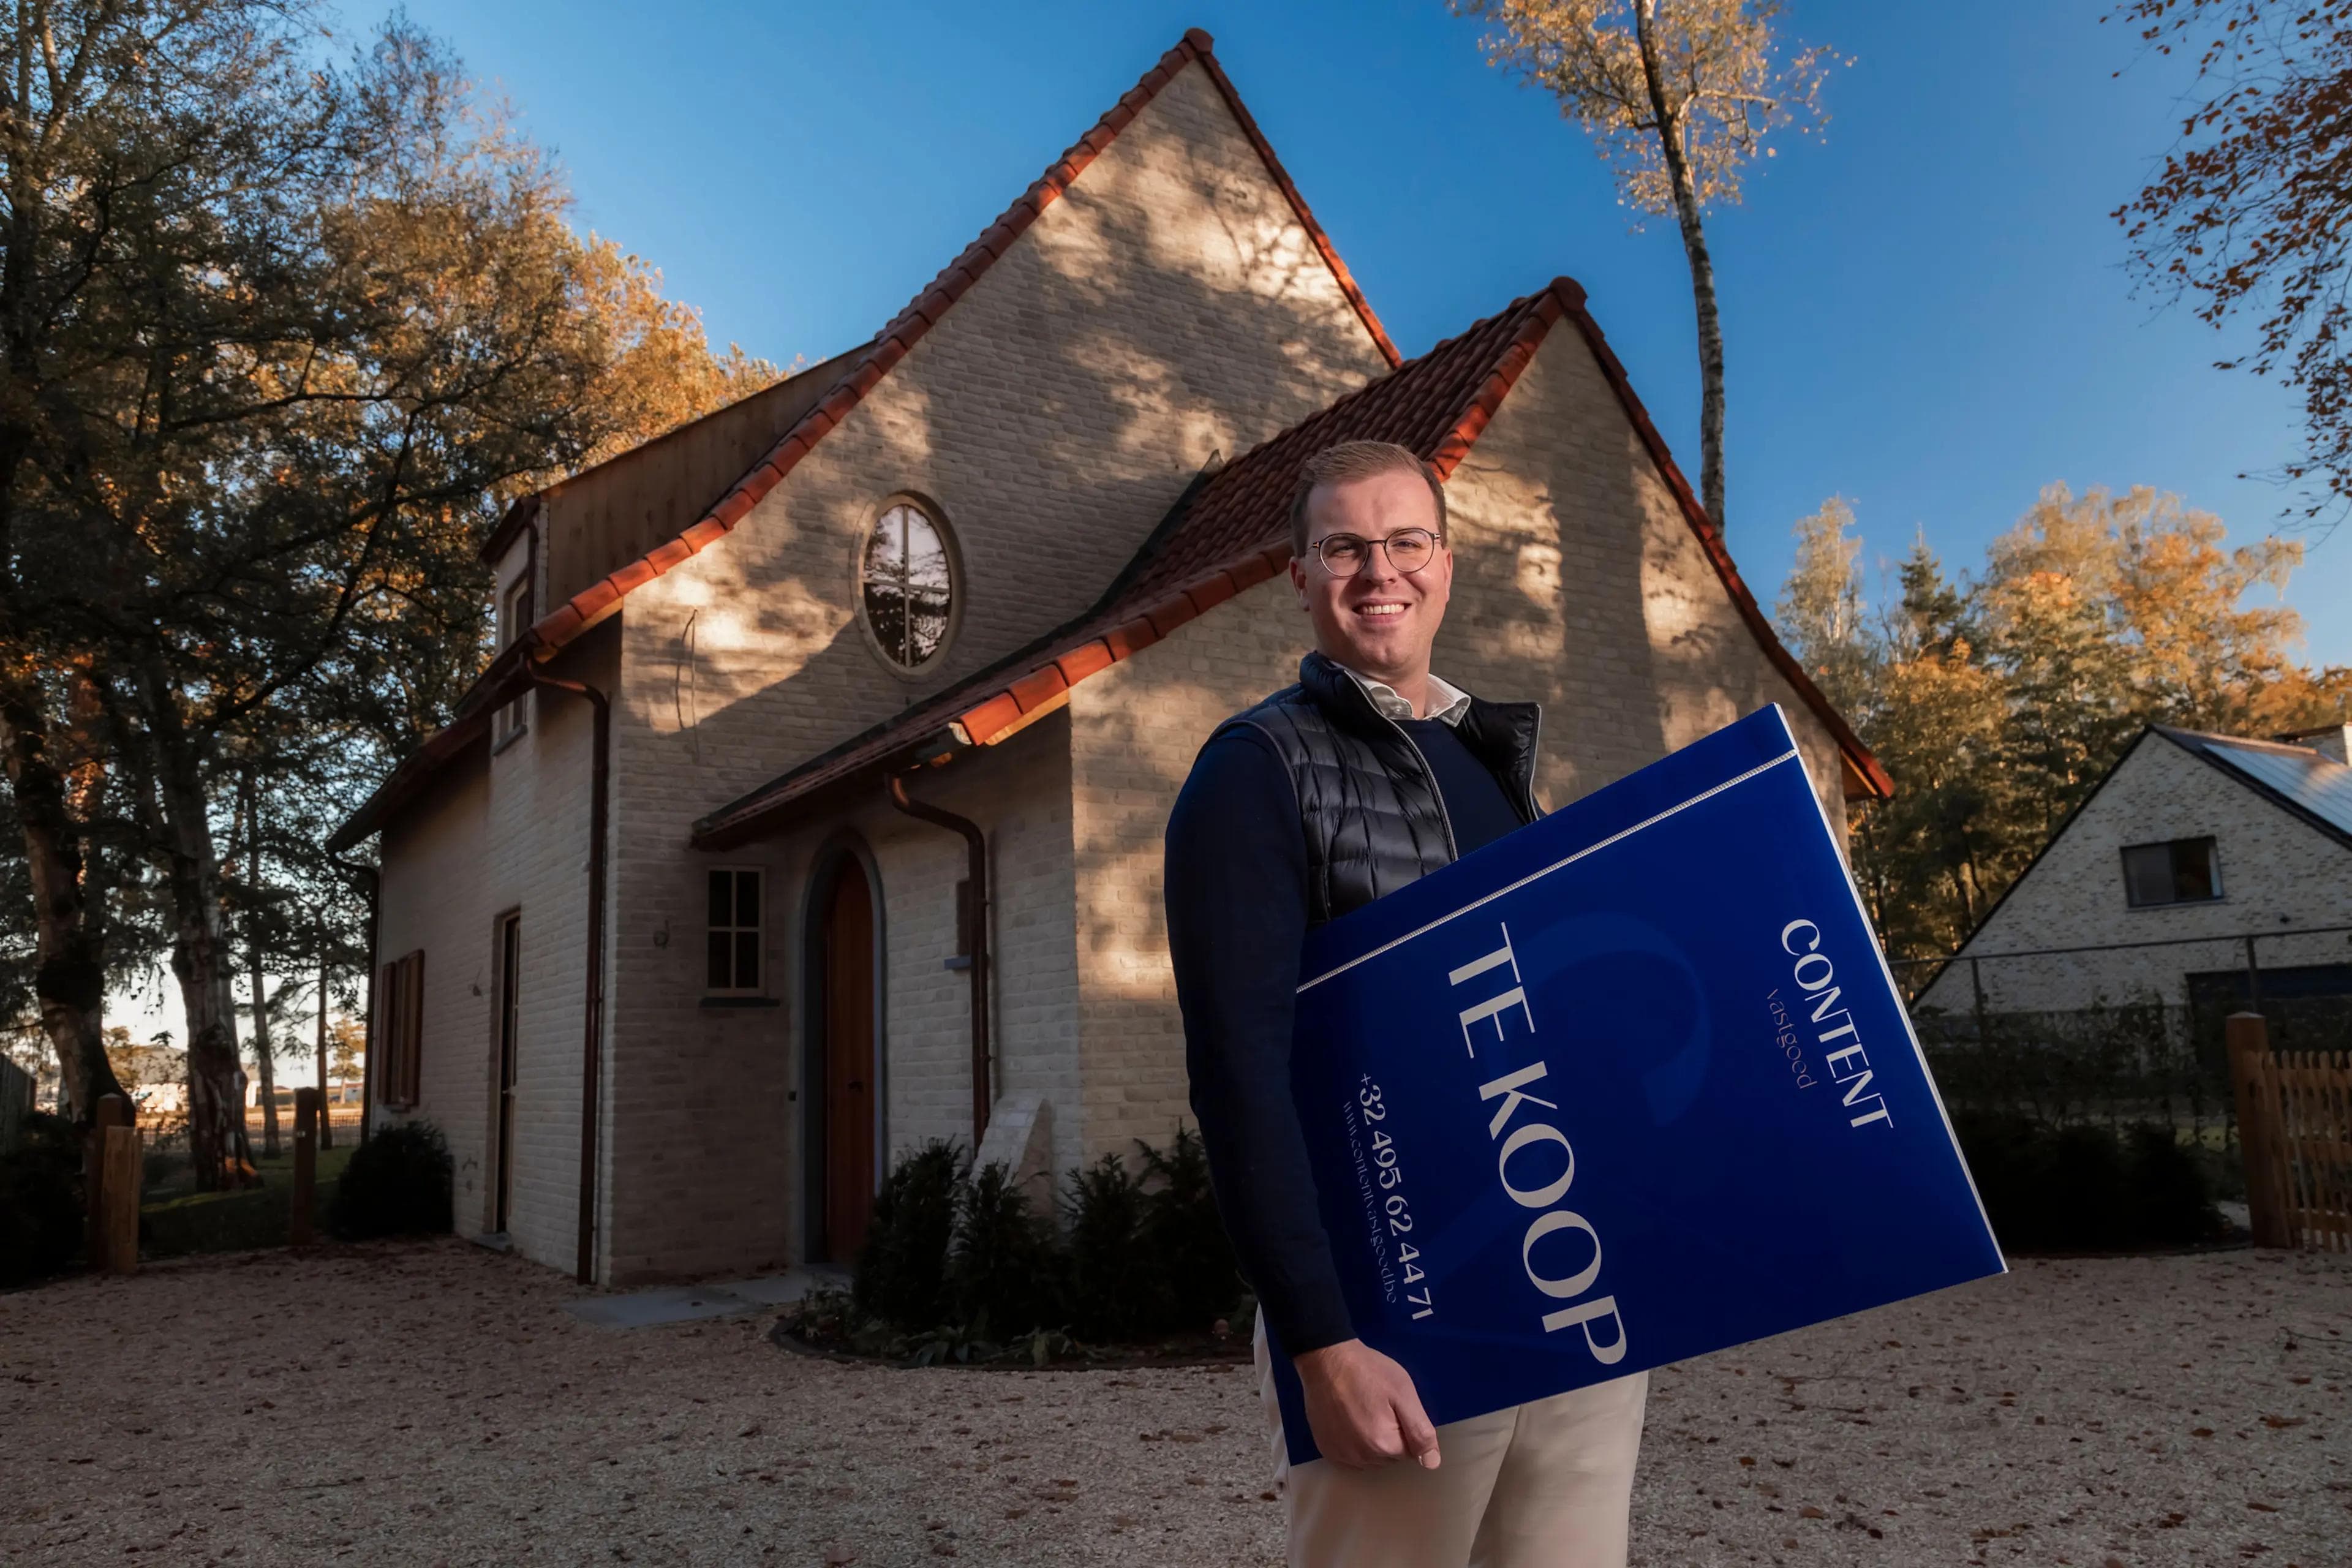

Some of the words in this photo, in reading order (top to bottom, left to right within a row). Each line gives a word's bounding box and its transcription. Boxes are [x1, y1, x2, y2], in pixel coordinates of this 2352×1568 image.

[1448, 921, 1536, 1059] TE
[1766, 988, 1818, 1089] vastgoed
[1781, 919, 1894, 1128] CONTENT
[1359, 1072, 1386, 1126] +32
[1372, 1131, 1402, 1189] 495
[1385, 1195, 1412, 1237] 62
[1479, 1060, 1627, 1365] KOOP
[1398, 1242, 1425, 1284] 44
[1407, 1287, 1433, 1320] 71
